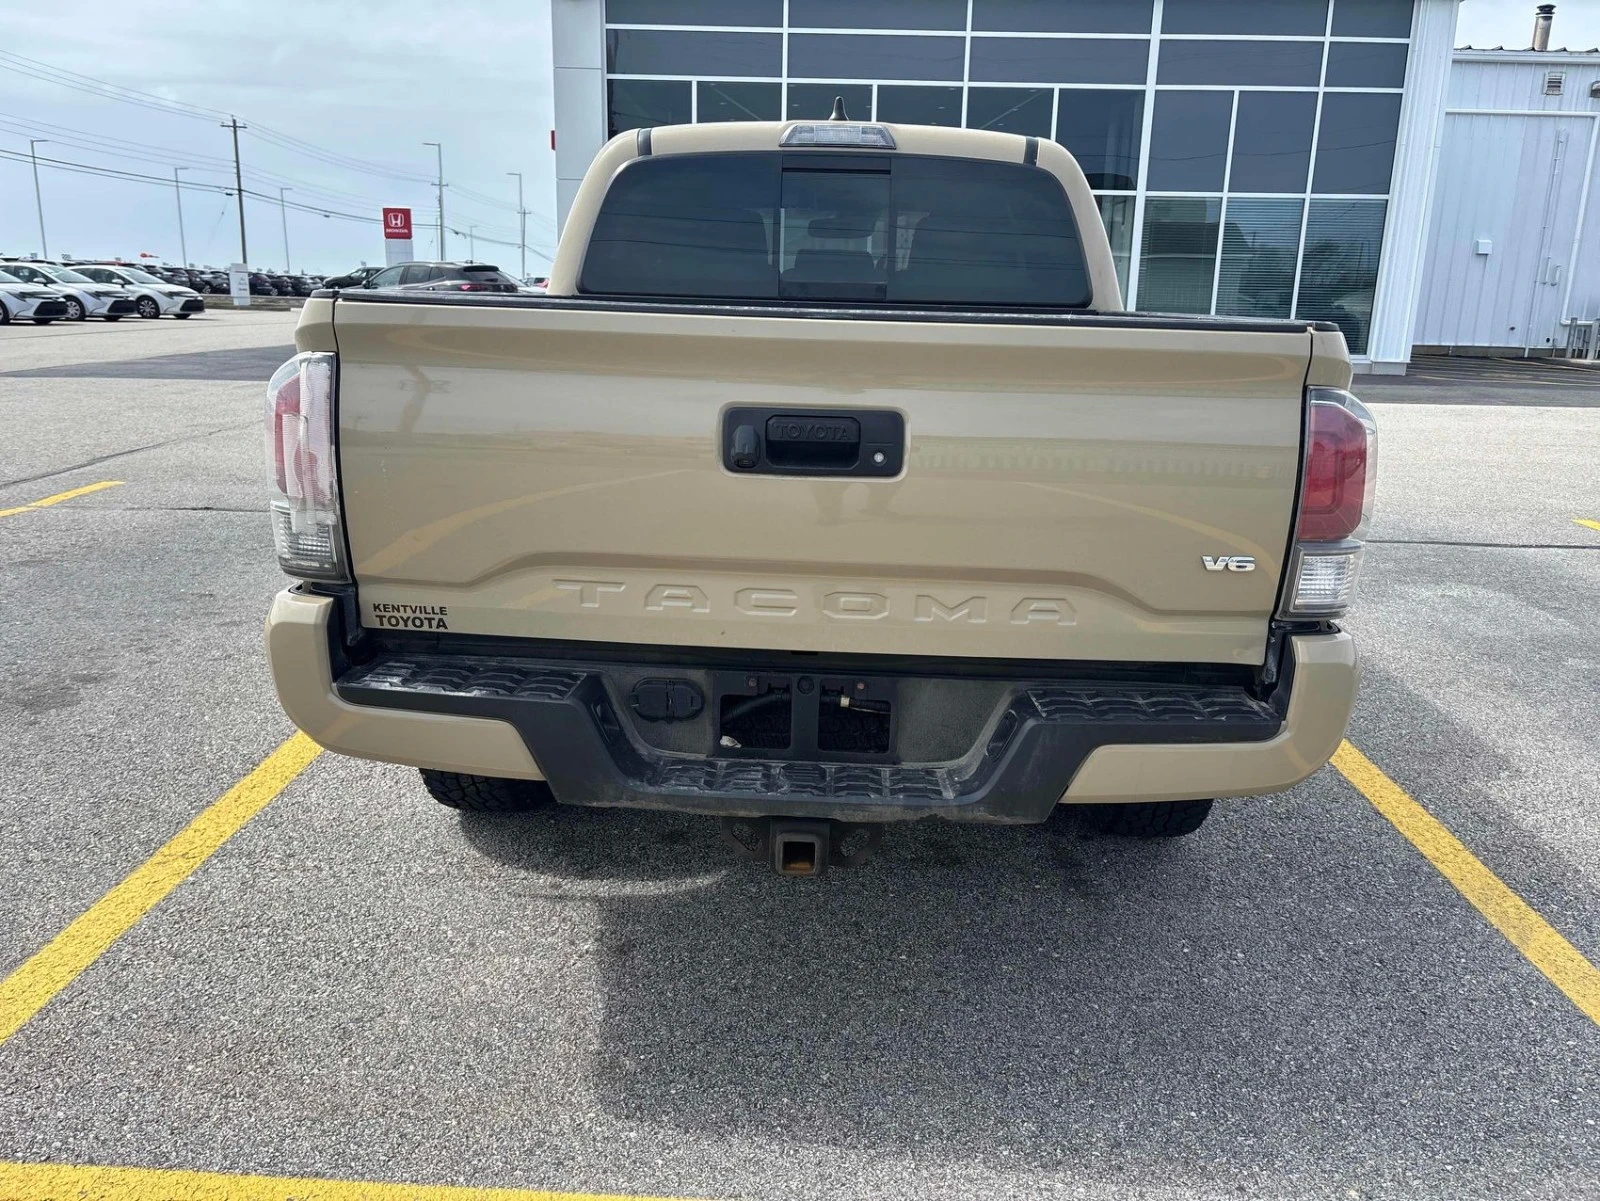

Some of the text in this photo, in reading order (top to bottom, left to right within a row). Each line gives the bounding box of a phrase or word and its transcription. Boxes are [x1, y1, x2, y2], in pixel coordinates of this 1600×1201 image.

[775, 423, 851, 441] TOYOTA
[1201, 555, 1256, 572] V6
[373, 603, 448, 616] KENTVILLE
[551, 578, 1078, 627] TACOMA
[375, 614, 449, 630] TOYOTA
